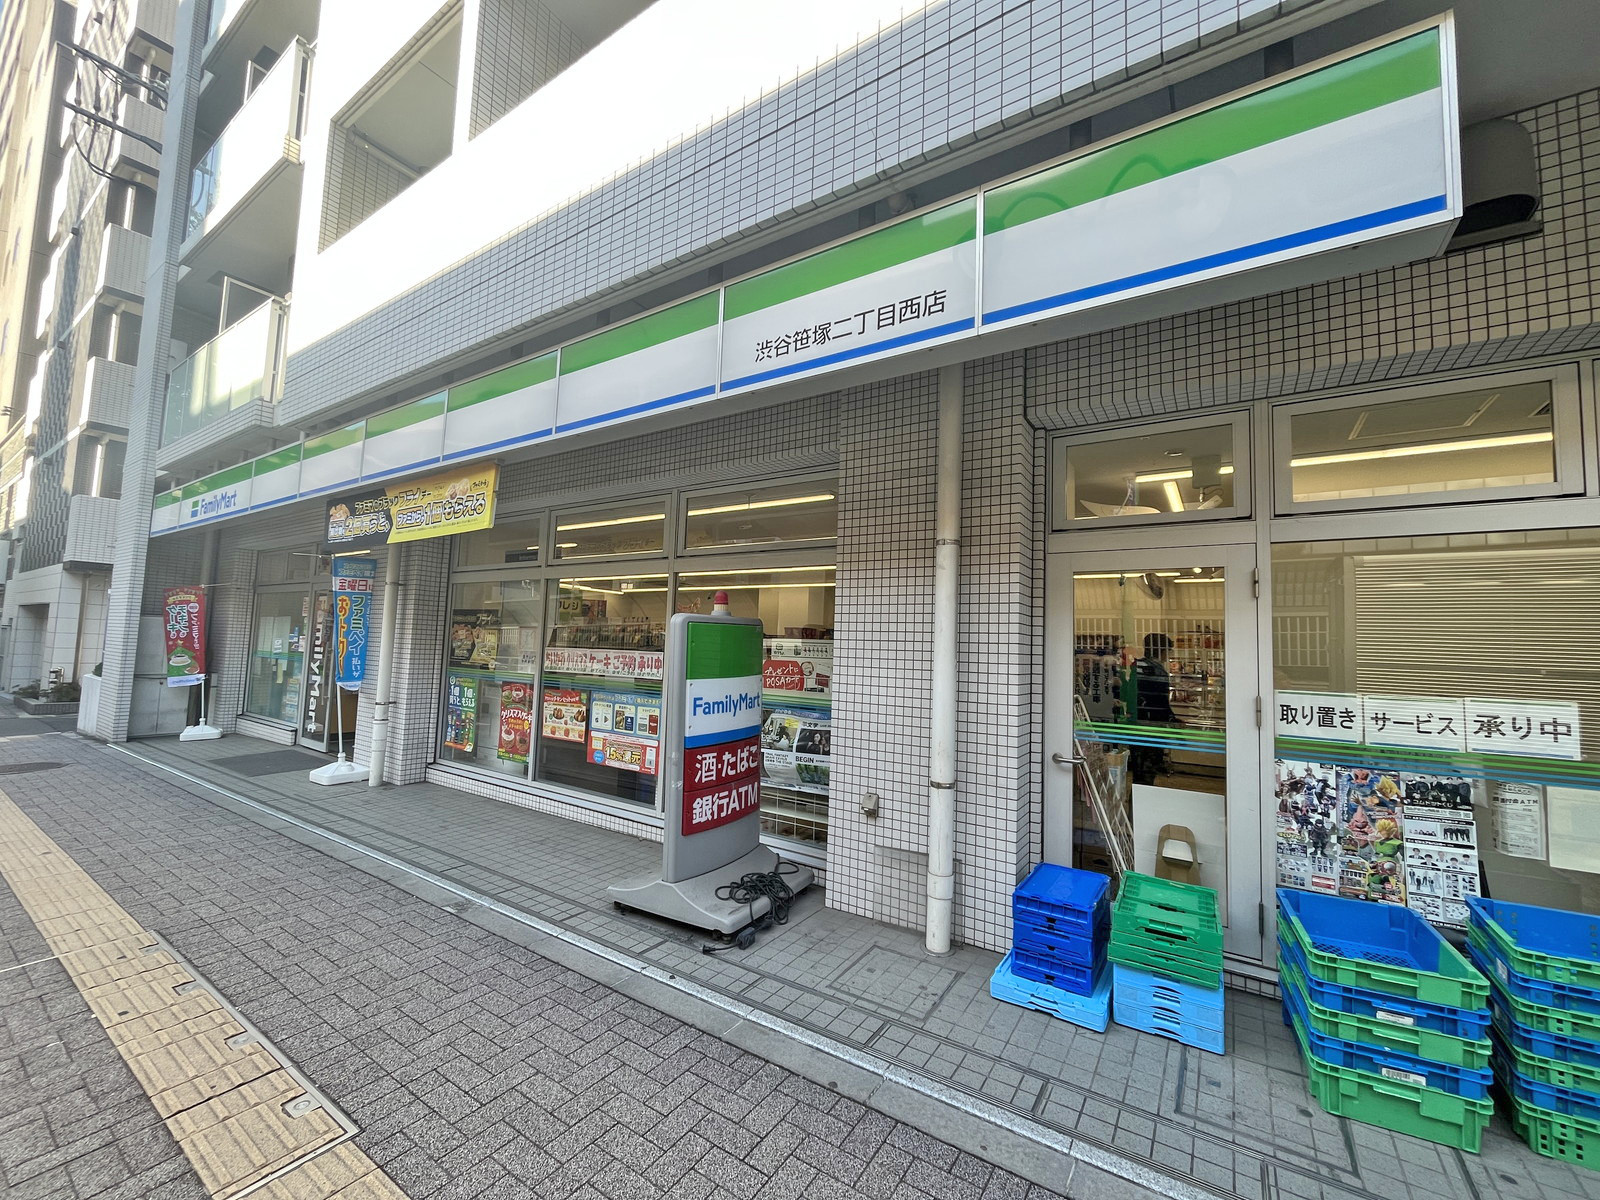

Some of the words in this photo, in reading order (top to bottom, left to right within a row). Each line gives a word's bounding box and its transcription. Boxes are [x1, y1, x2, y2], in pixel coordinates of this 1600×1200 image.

[754, 289, 947, 363] 渋谷笹塚二丁目西店
[200, 489, 237, 515] FamilyMart
[349, 595, 365, 656] ファミペイ
[307, 595, 328, 734] FamilyMart
[588, 653, 611, 670] ケーキ
[612, 655, 637, 673] ご予約
[637, 655, 662, 674] 承り中
[692, 692, 761, 717] FamilyMart
[1279, 704, 1357, 729] 取り置き
[1370, 712, 1458, 736] サービス
[1472, 713, 1572, 743] 承り中
[694, 744, 759, 784] 酒・たばこ
[795, 755, 815, 763] BEGIN
[692, 781, 759, 825] 銀行ATM
